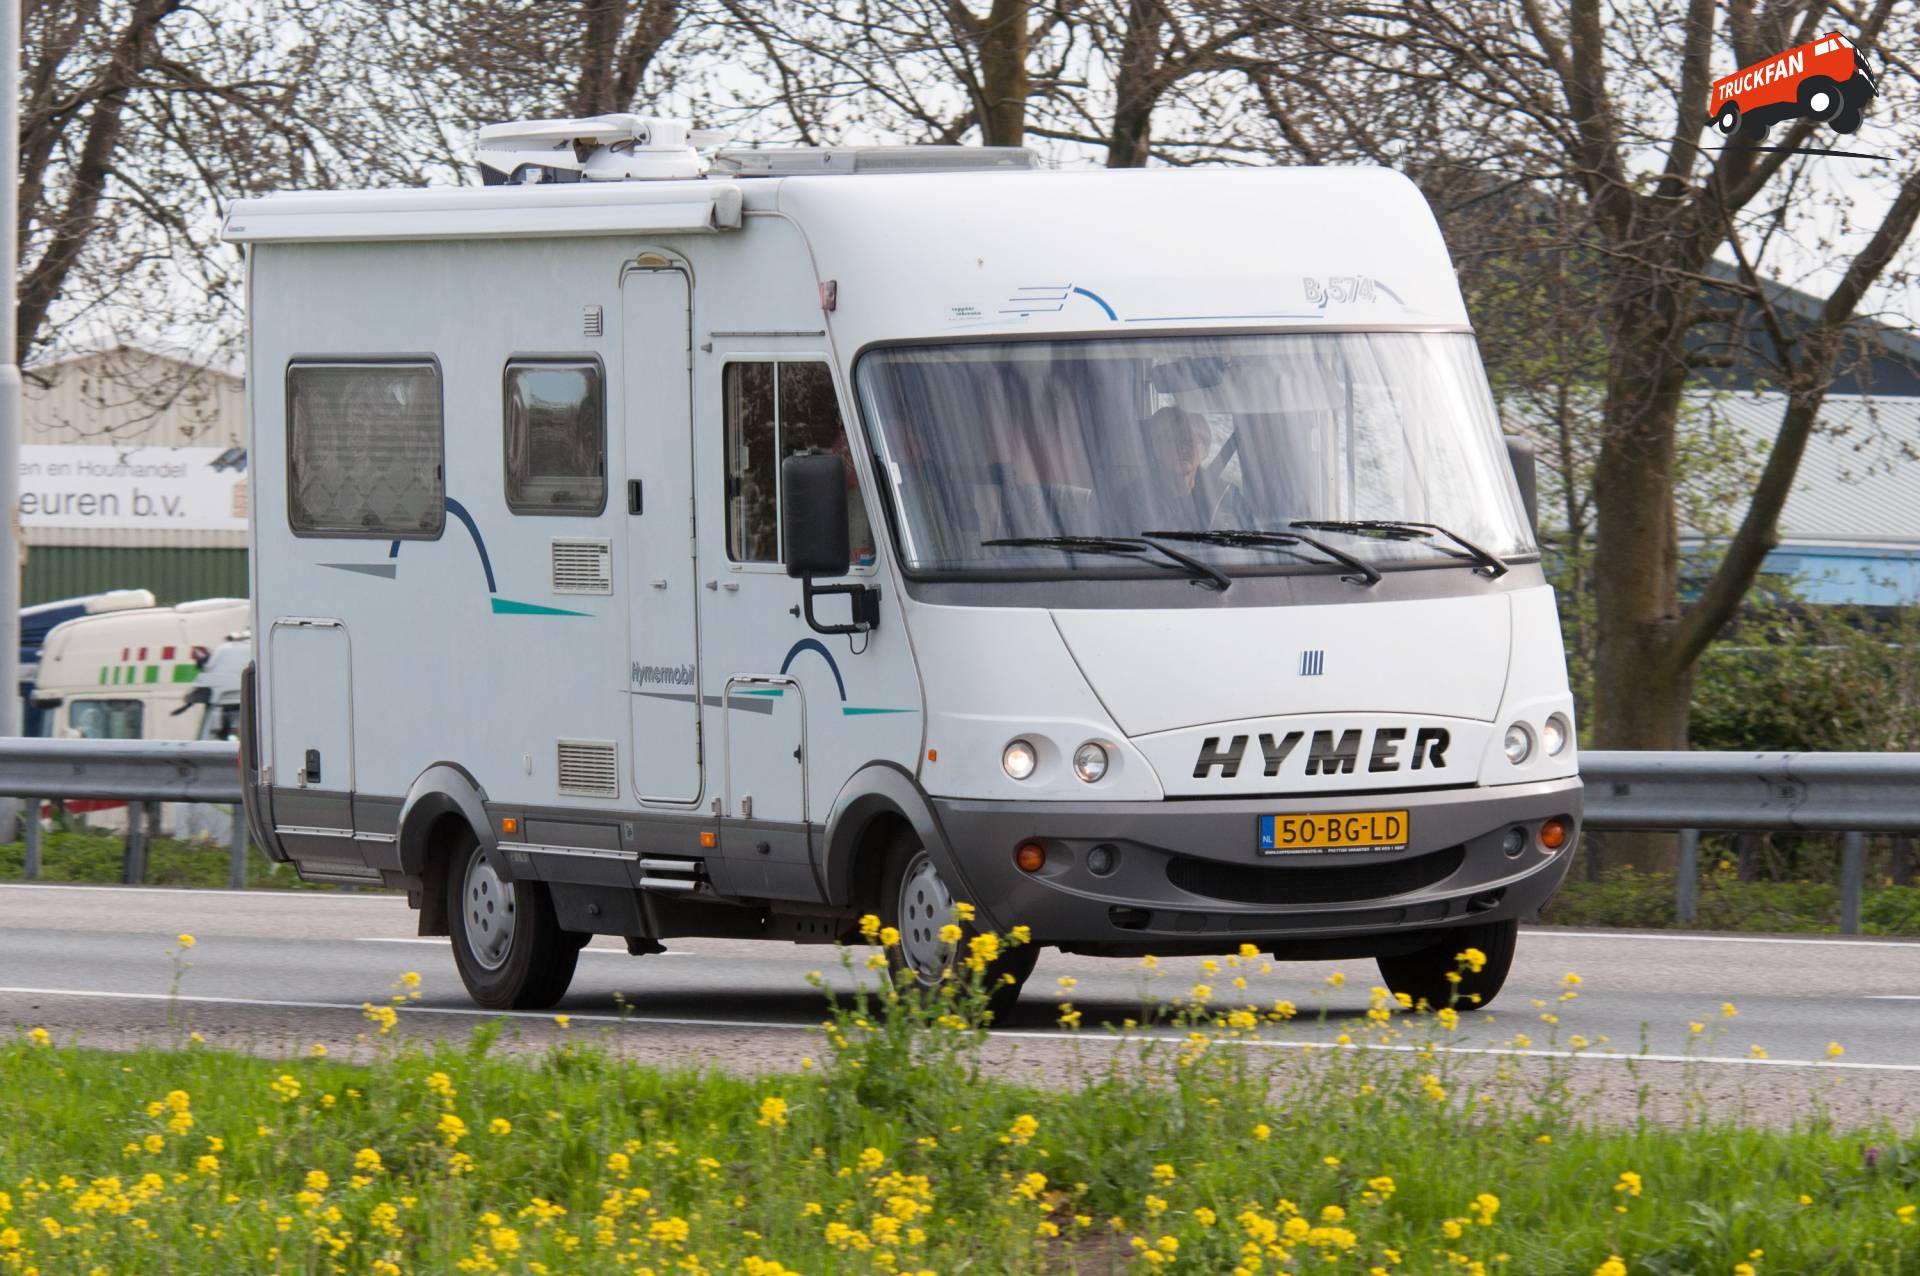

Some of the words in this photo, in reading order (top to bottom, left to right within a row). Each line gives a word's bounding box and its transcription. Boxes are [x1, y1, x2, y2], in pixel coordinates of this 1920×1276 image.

[47, 463, 71, 477] en
[76, 460, 188, 479] Houthandel
[19, 491, 119, 516] euren
[132, 487, 186, 517] b.v.
[631, 661, 696, 687] Hymermobil
[1192, 727, 1451, 779] HYMER
[1262, 834, 1273, 844] NL
[1282, 815, 1400, 844] 50-BG-LD
